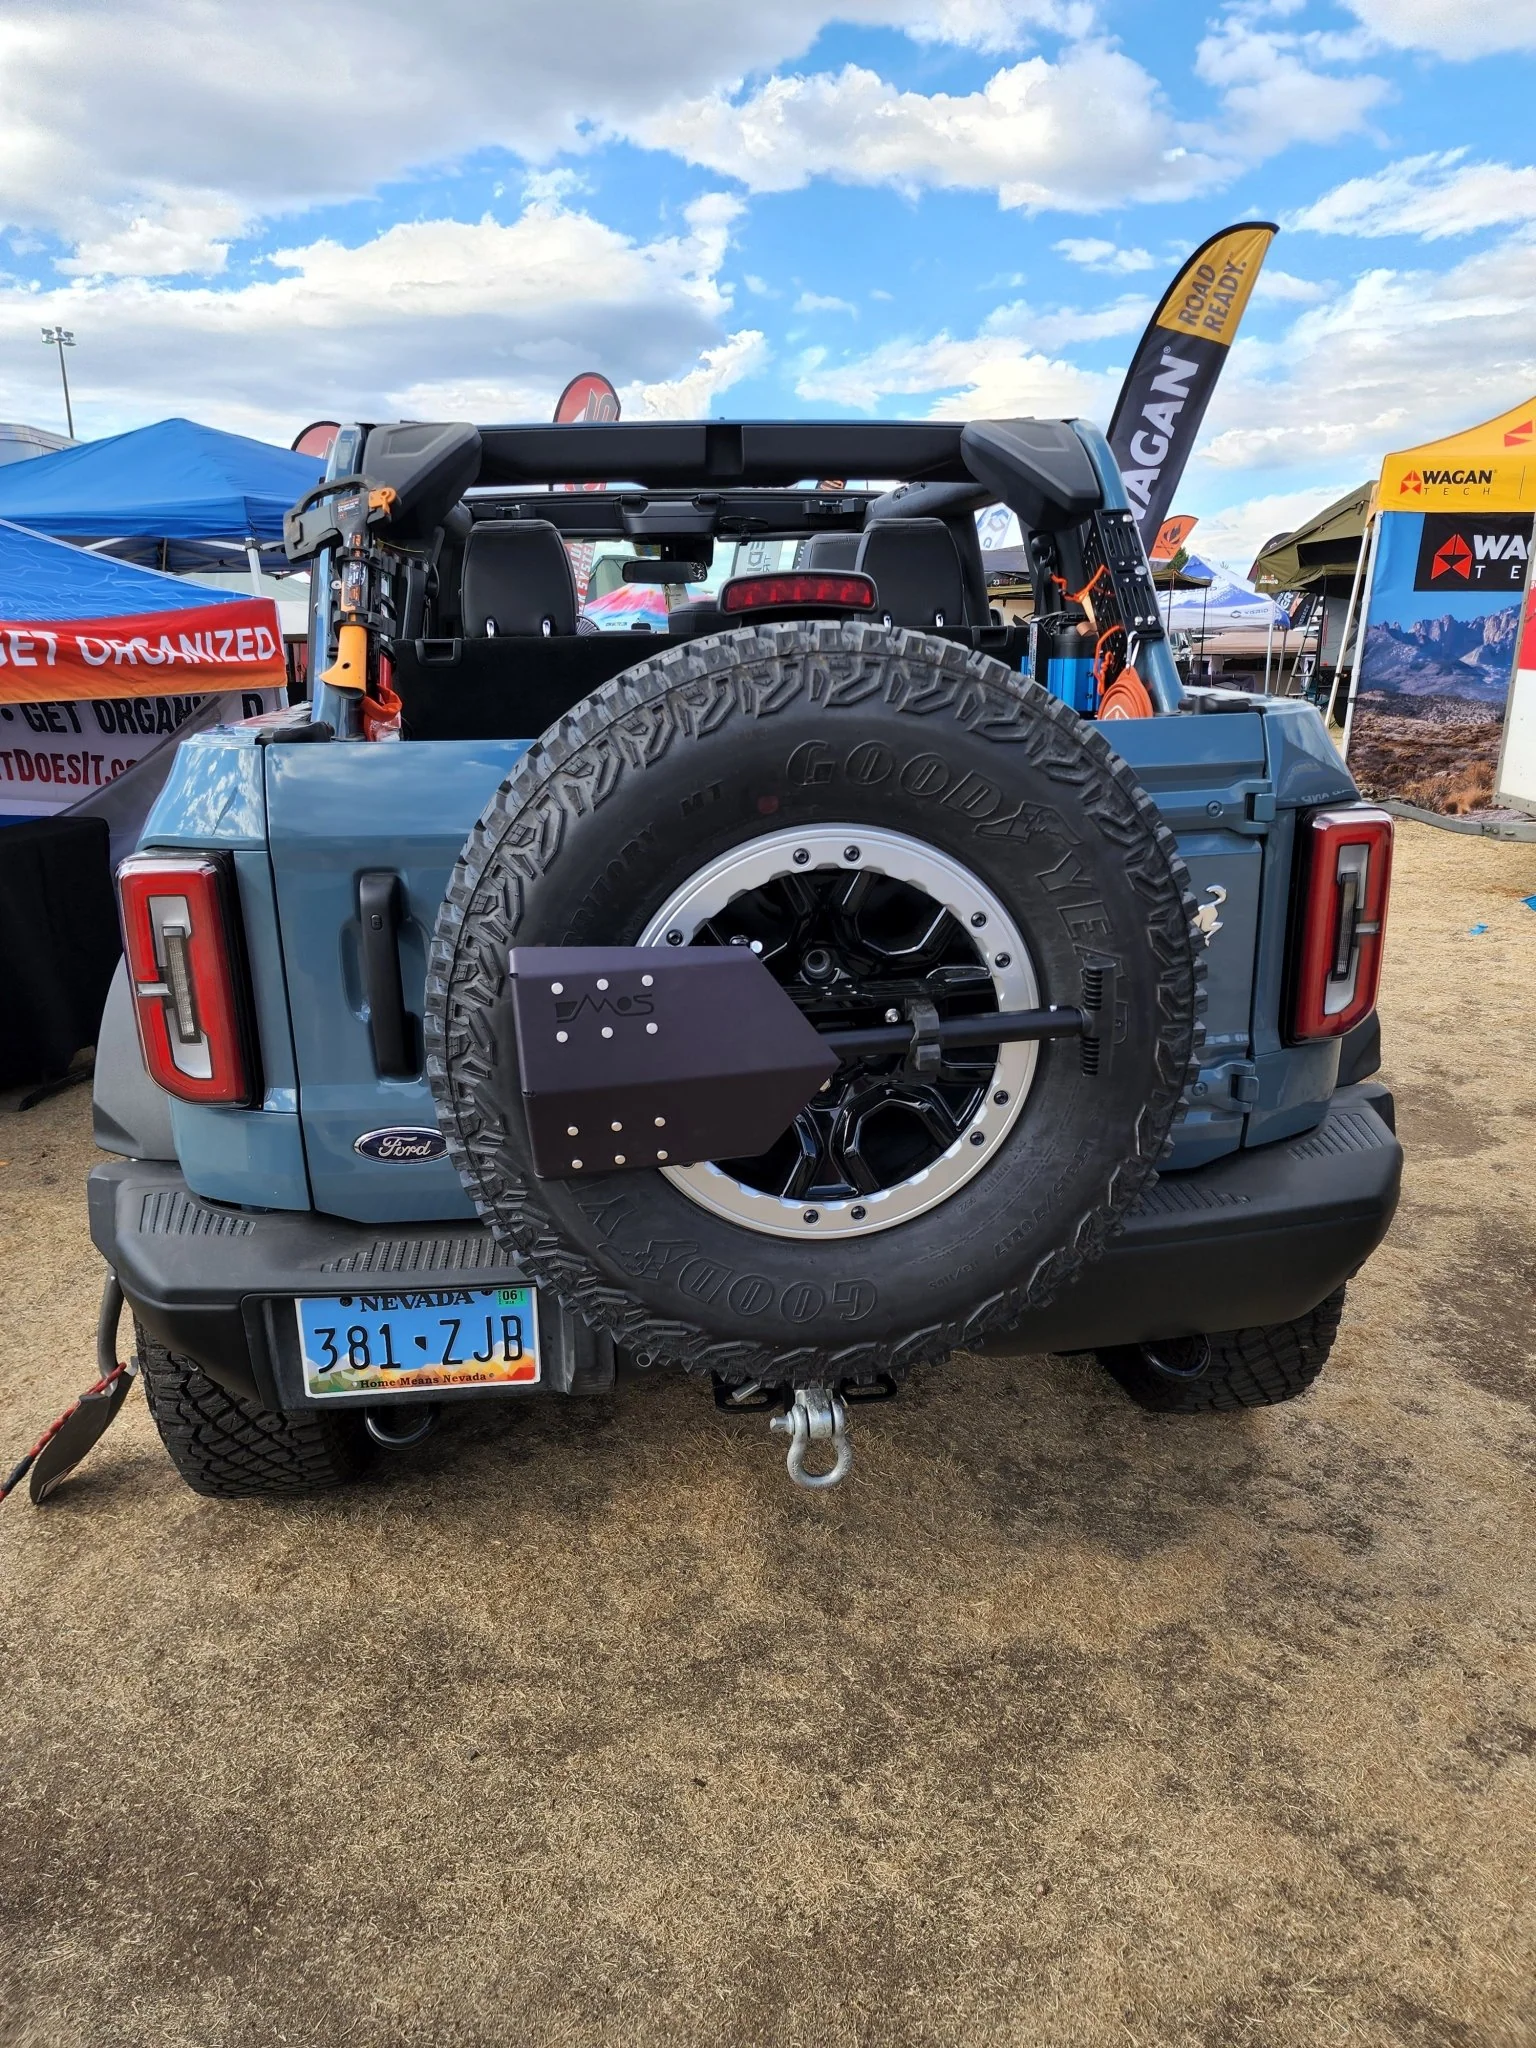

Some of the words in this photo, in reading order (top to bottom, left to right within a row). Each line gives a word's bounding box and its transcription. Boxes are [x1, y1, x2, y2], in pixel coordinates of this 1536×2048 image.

[1178, 264, 1216, 327] ROAD
[1203, 259, 1249, 334] READY.
[1121, 353, 1200, 521] AGAN
[1422, 470, 1493, 485] WAGAN
[1424, 487, 1490, 496] TECH
[1473, 534, 1531, 560] WA
[0, 629, 59, 667] ET
[75, 626, 276, 667] ORGANIZED
[20, 700, 83, 735] GET
[0, 748, 138, 786] TDOESIT.C
[378, 1136, 432, 1158] Ford
[564, 1182, 878, 1323] GOODY
[360, 1290, 475, 1313] NEVADA
[502, 1289, 518, 1301] 06
[313, 1323, 401, 1374] 381
[438, 1315, 524, 1366] ZJB
[360, 1379, 397, 1389] Home
[400, 1375, 440, 1387] Means
[443, 1373, 487, 1382] Nevada
